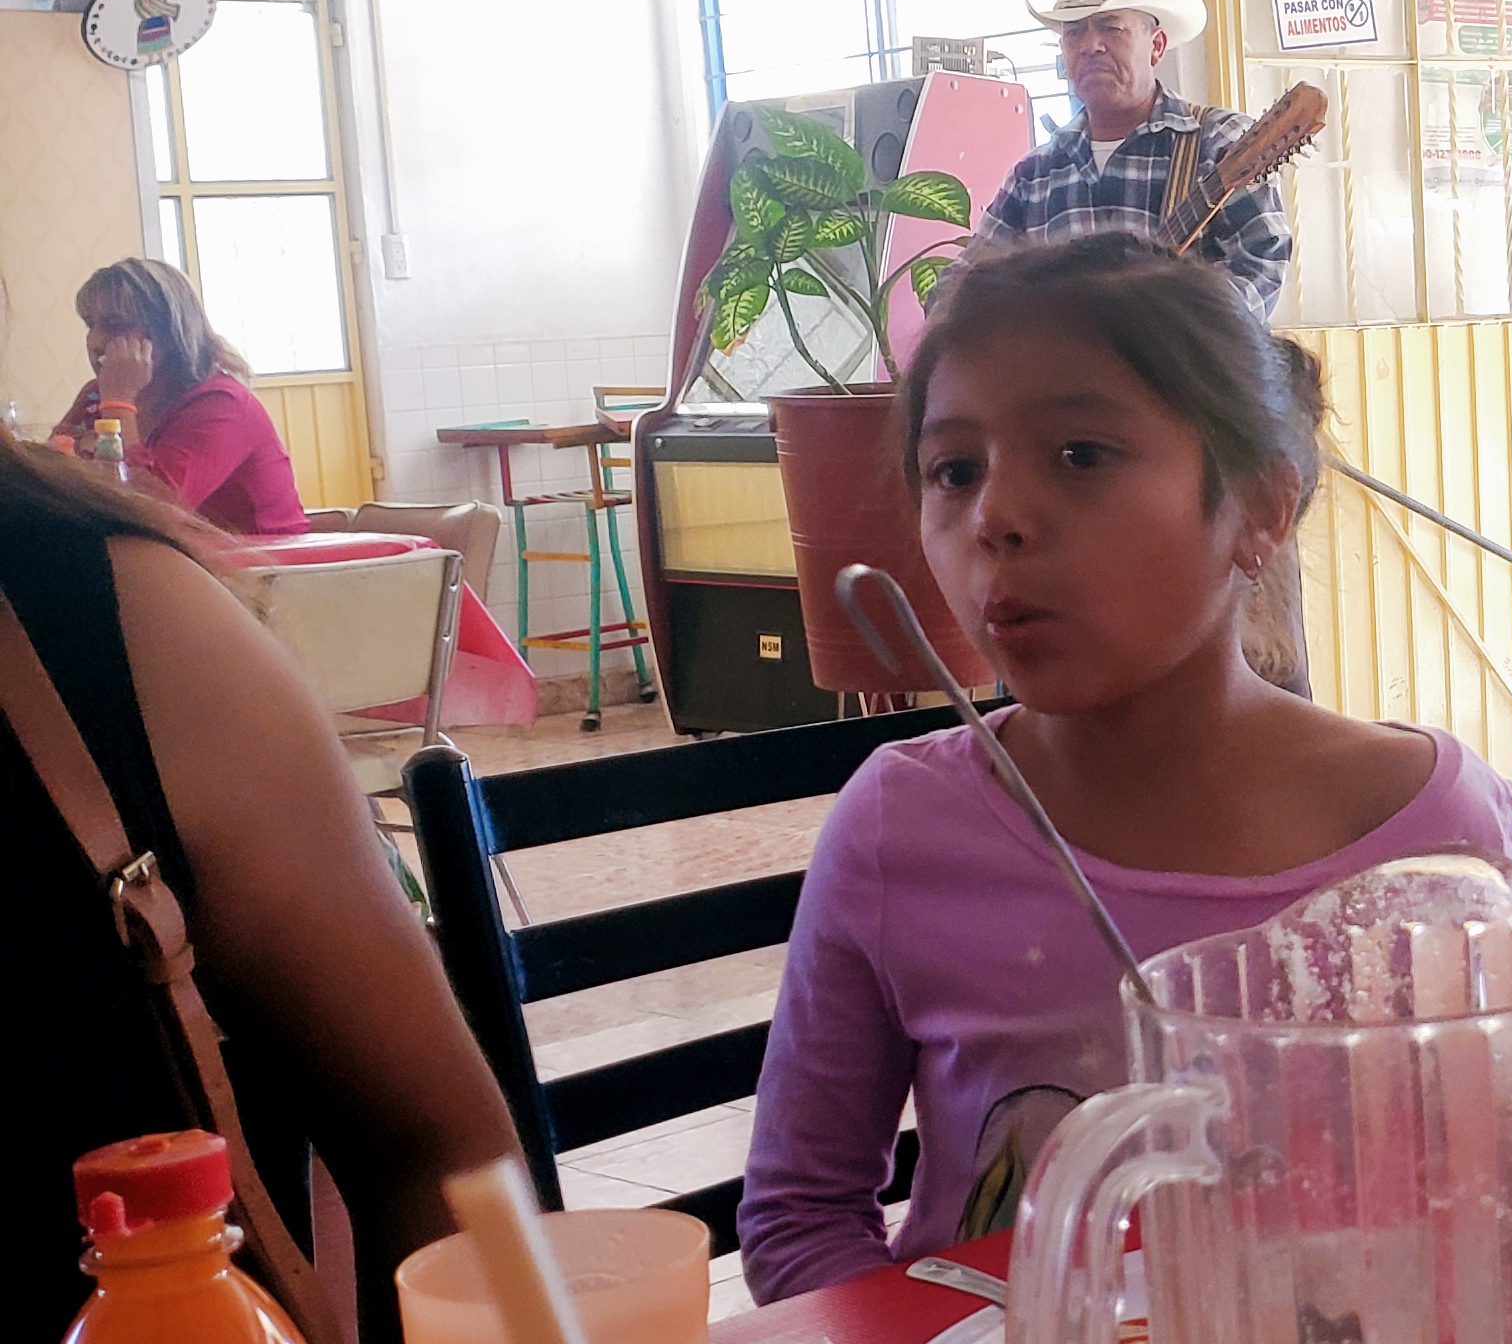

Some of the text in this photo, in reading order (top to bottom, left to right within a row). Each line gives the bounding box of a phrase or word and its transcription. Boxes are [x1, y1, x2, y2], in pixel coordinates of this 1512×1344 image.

[1284, 0, 1319, 14] PASAR
[1288, 16, 1347, 36] ALIMENTOS
[761, 641, 779, 652] NSM
